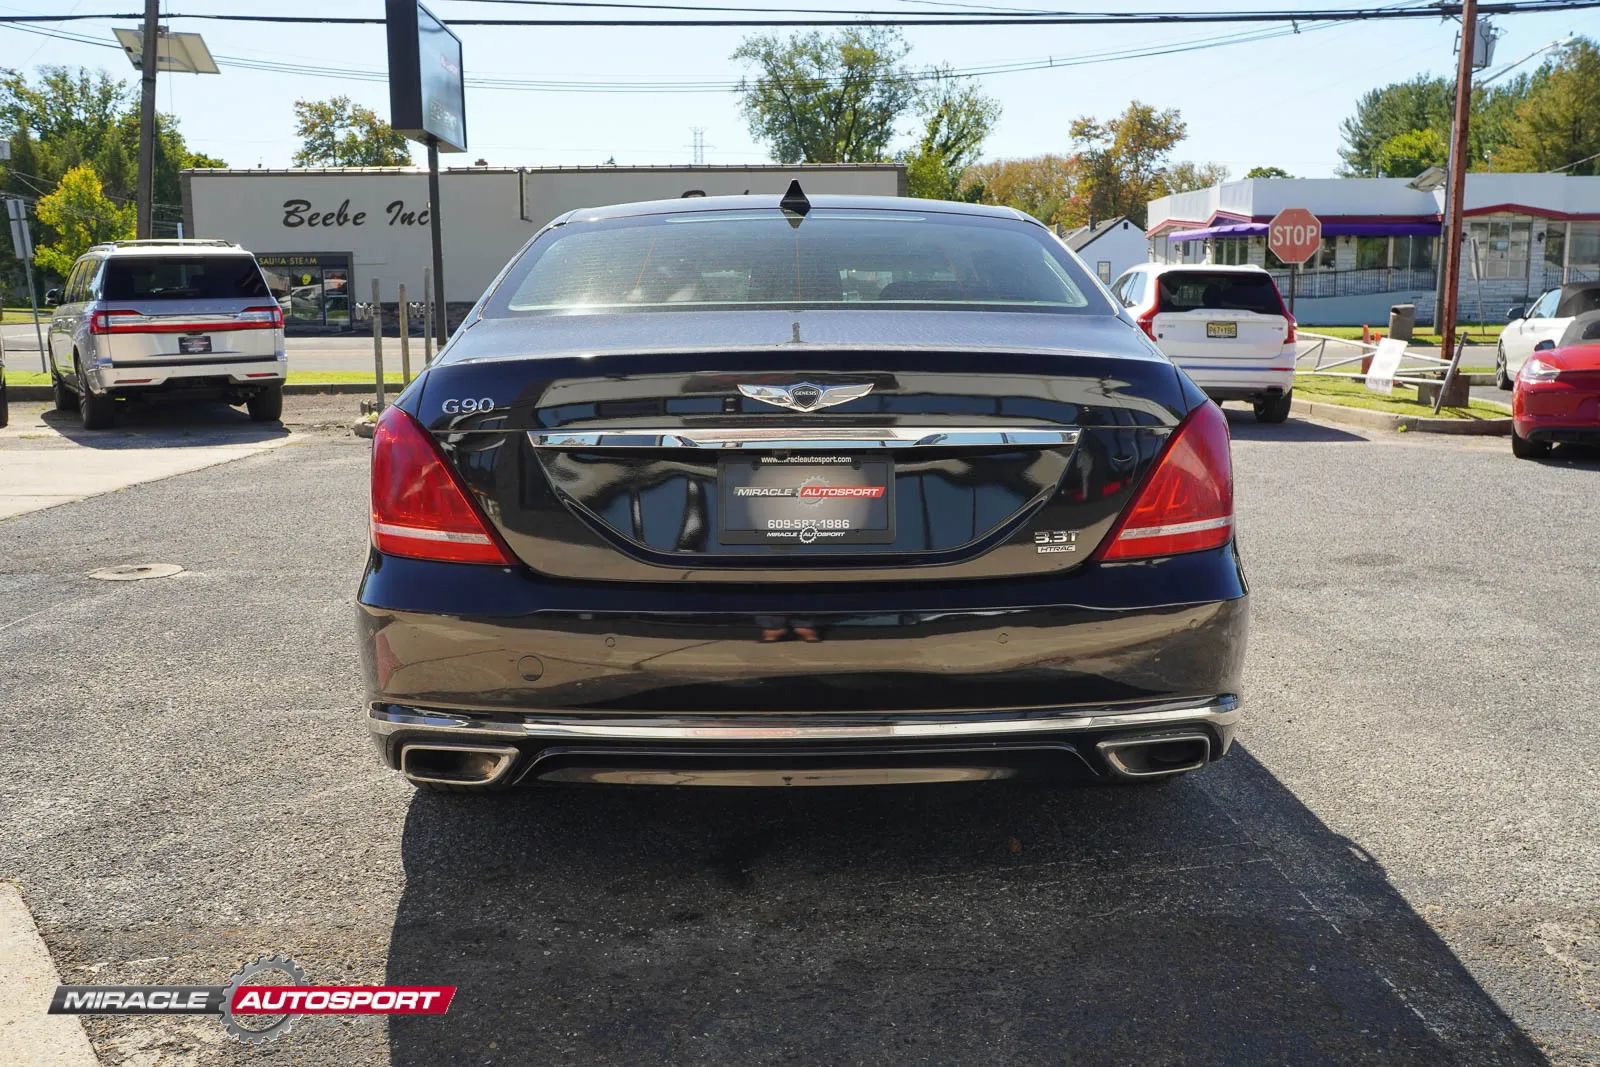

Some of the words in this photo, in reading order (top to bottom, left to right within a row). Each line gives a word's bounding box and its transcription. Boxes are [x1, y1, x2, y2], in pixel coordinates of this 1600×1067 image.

[283, 198, 367, 228] Beebe
[1272, 225, 1317, 246] STOP
[441, 397, 495, 414] G90
[736, 487, 792, 496] MIRACLE
[801, 487, 880, 496] AUTOSPORT
[767, 519, 850, 529] 609-587-1986
[1034, 530, 1080, 544] 3.3T
